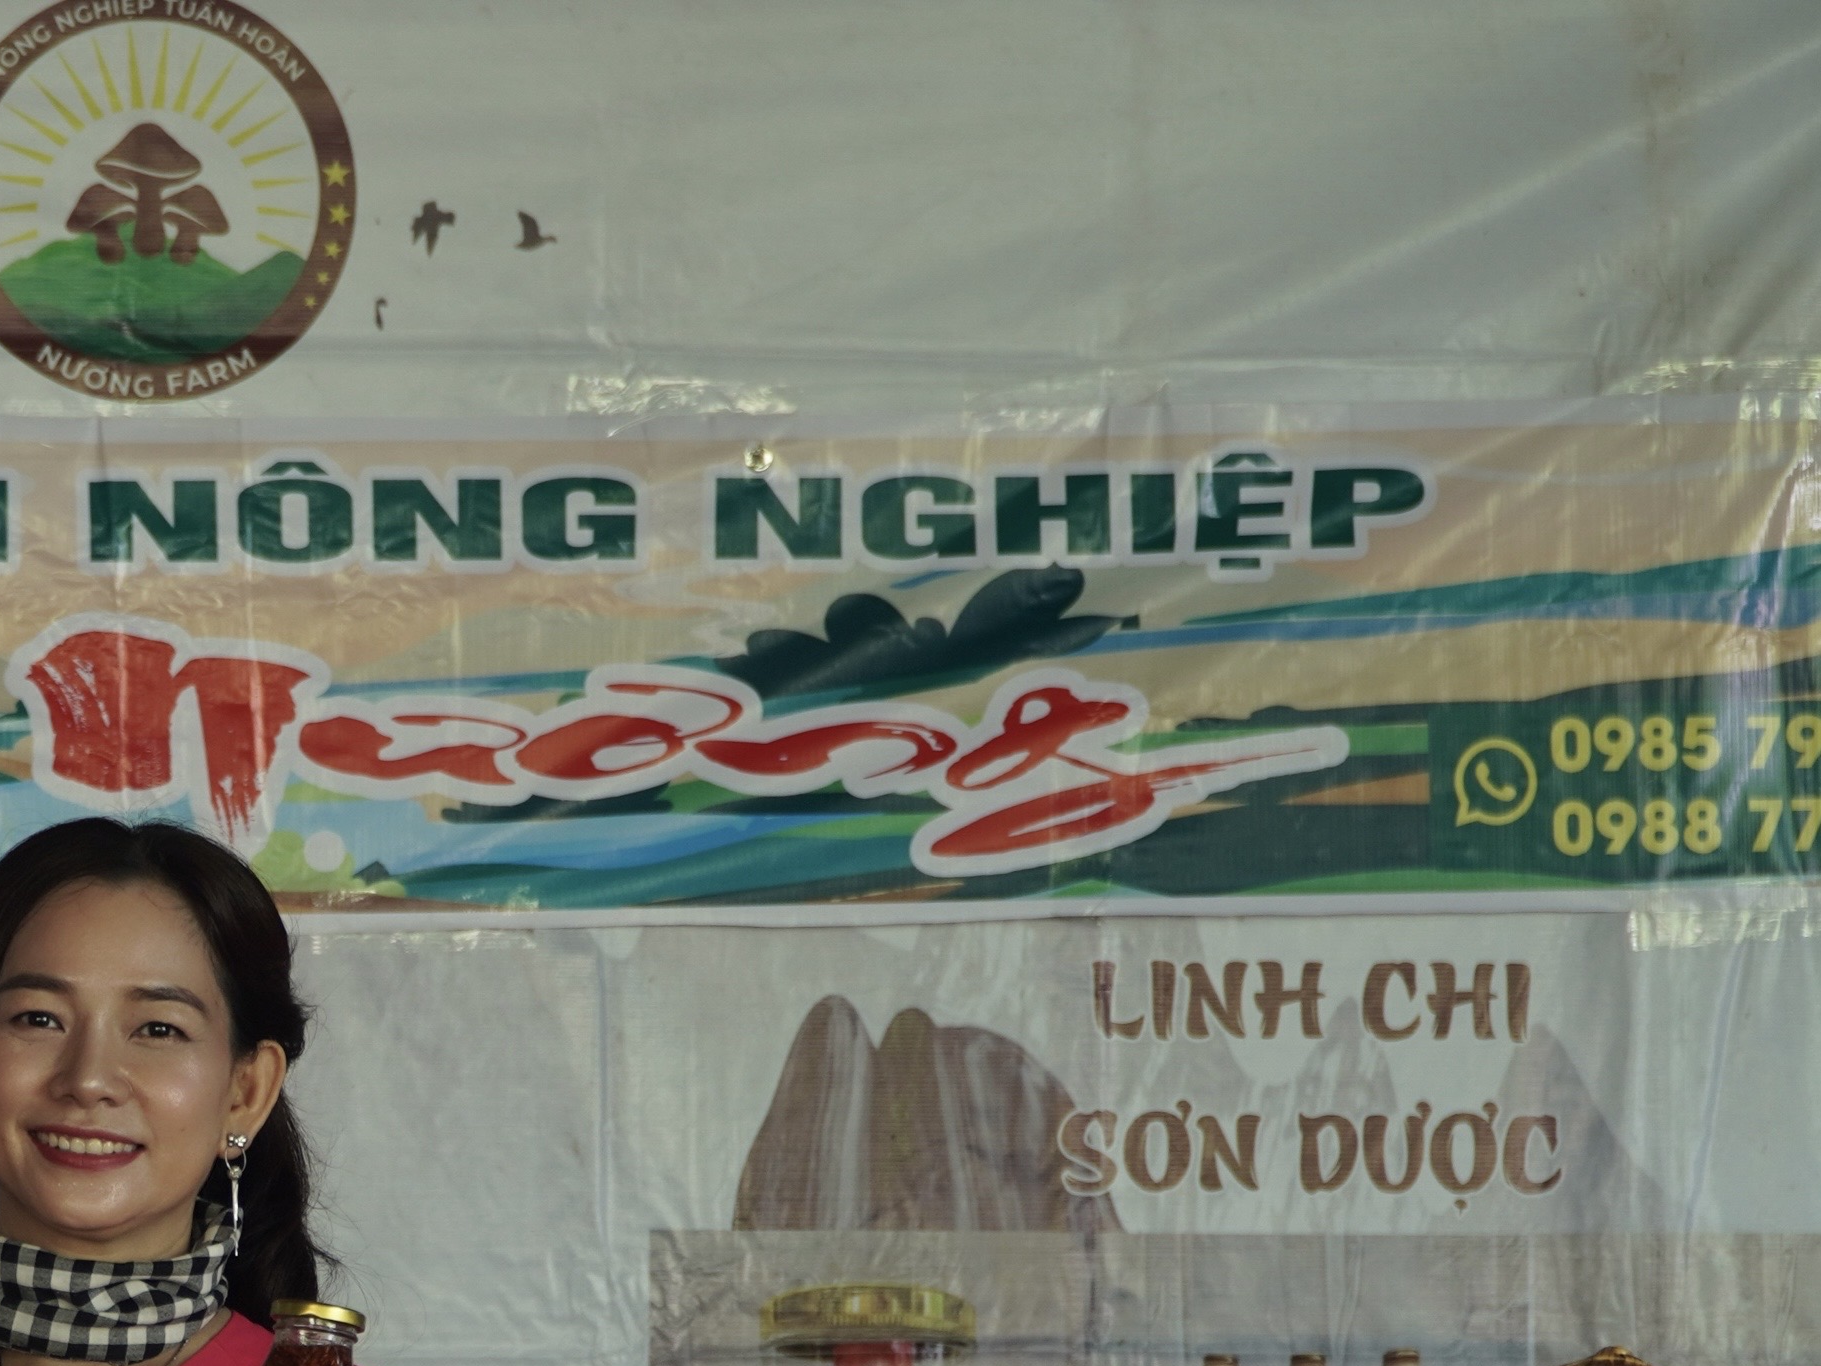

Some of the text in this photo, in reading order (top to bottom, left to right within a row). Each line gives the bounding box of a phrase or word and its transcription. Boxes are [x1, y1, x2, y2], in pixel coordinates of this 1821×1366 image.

[237, 22, 306, 82] HOÀN
[37, 344, 258, 399] NƯƠNG FARM
[88, 462, 636, 563] NÔNG
[715, 455, 1424, 569] NGHIỆP
[1550, 714, 1821, 772] 0985 79
[1553, 798, 1821, 857] 0988 77
[1092, 961, 1531, 1043] LINH CHI
[1060, 1100, 1562, 1214] SƠN DƯỢC
